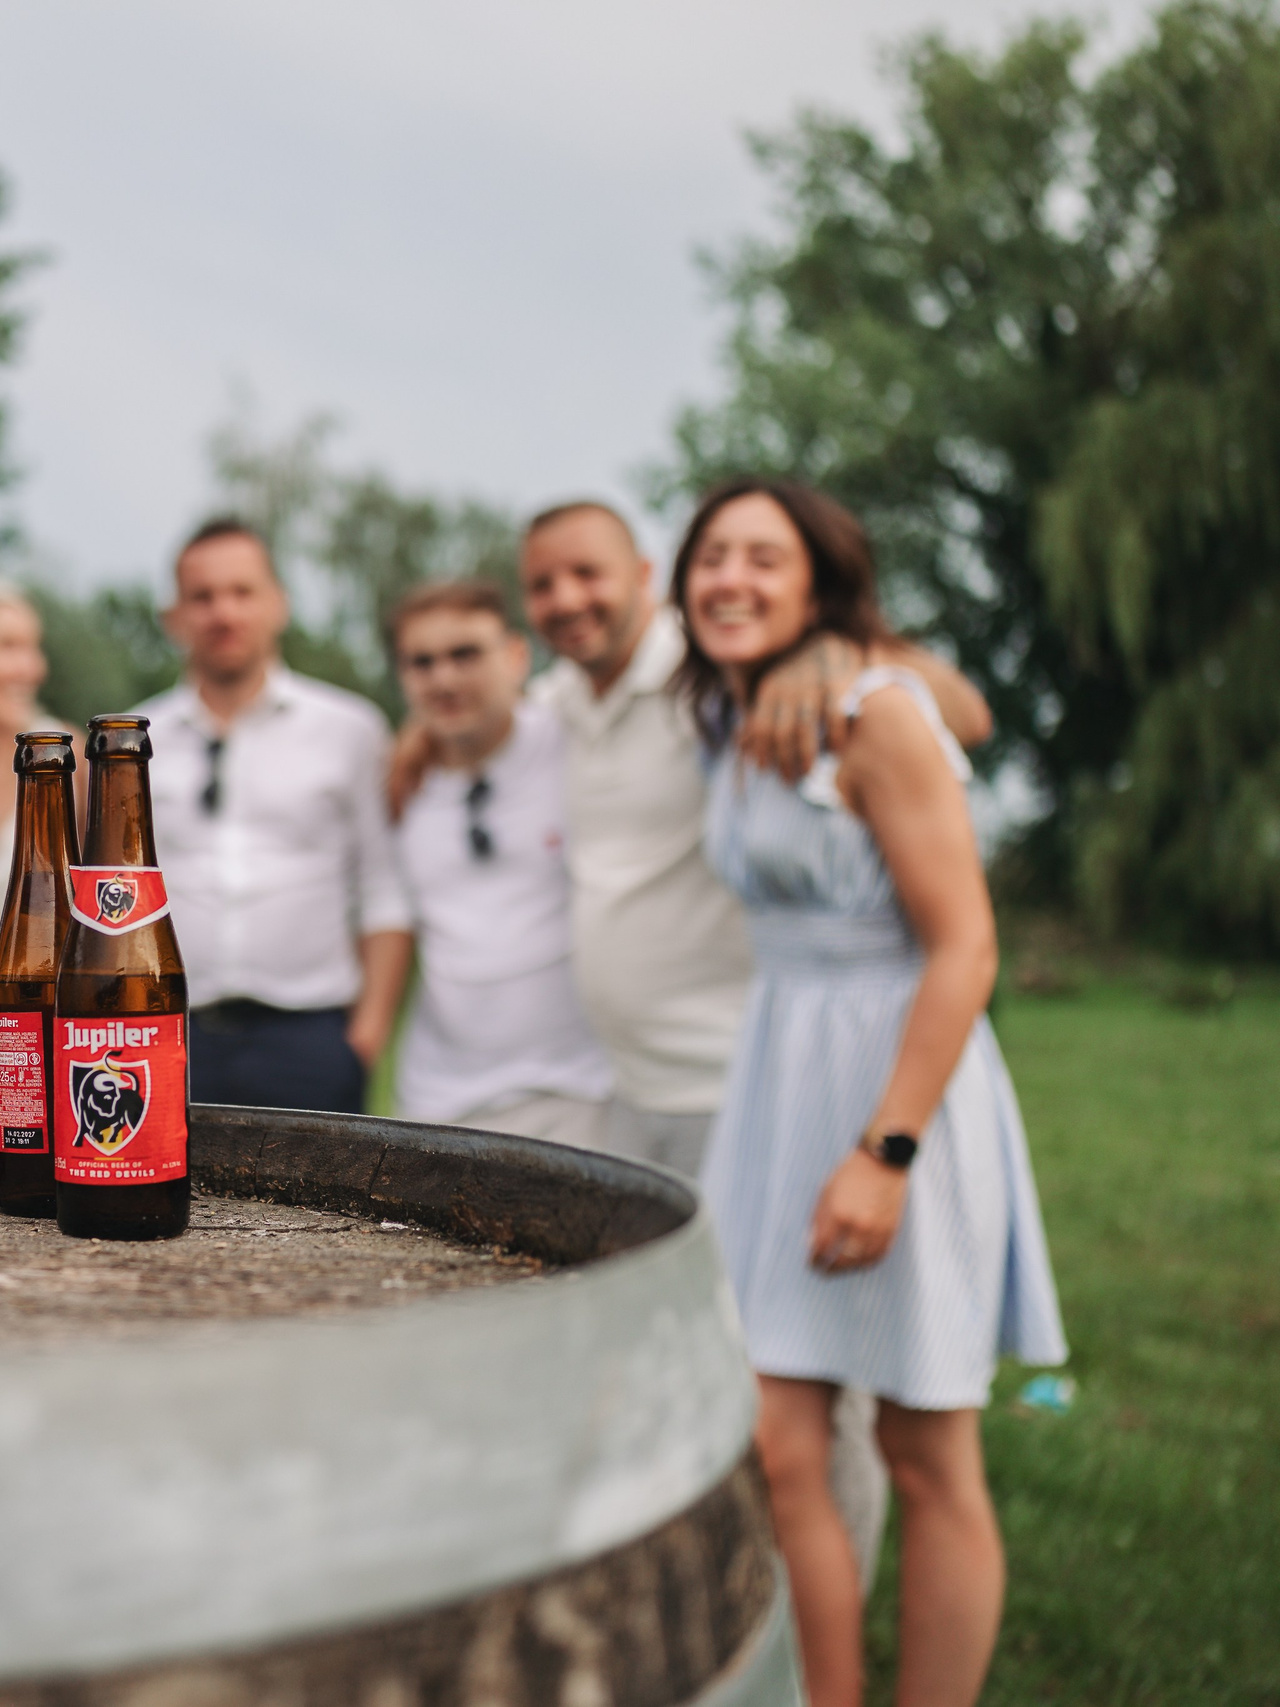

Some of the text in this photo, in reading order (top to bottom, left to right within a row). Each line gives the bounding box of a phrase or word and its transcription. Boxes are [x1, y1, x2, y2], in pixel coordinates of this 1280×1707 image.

[69, 1168, 155, 1178] THE RED DEVILS
